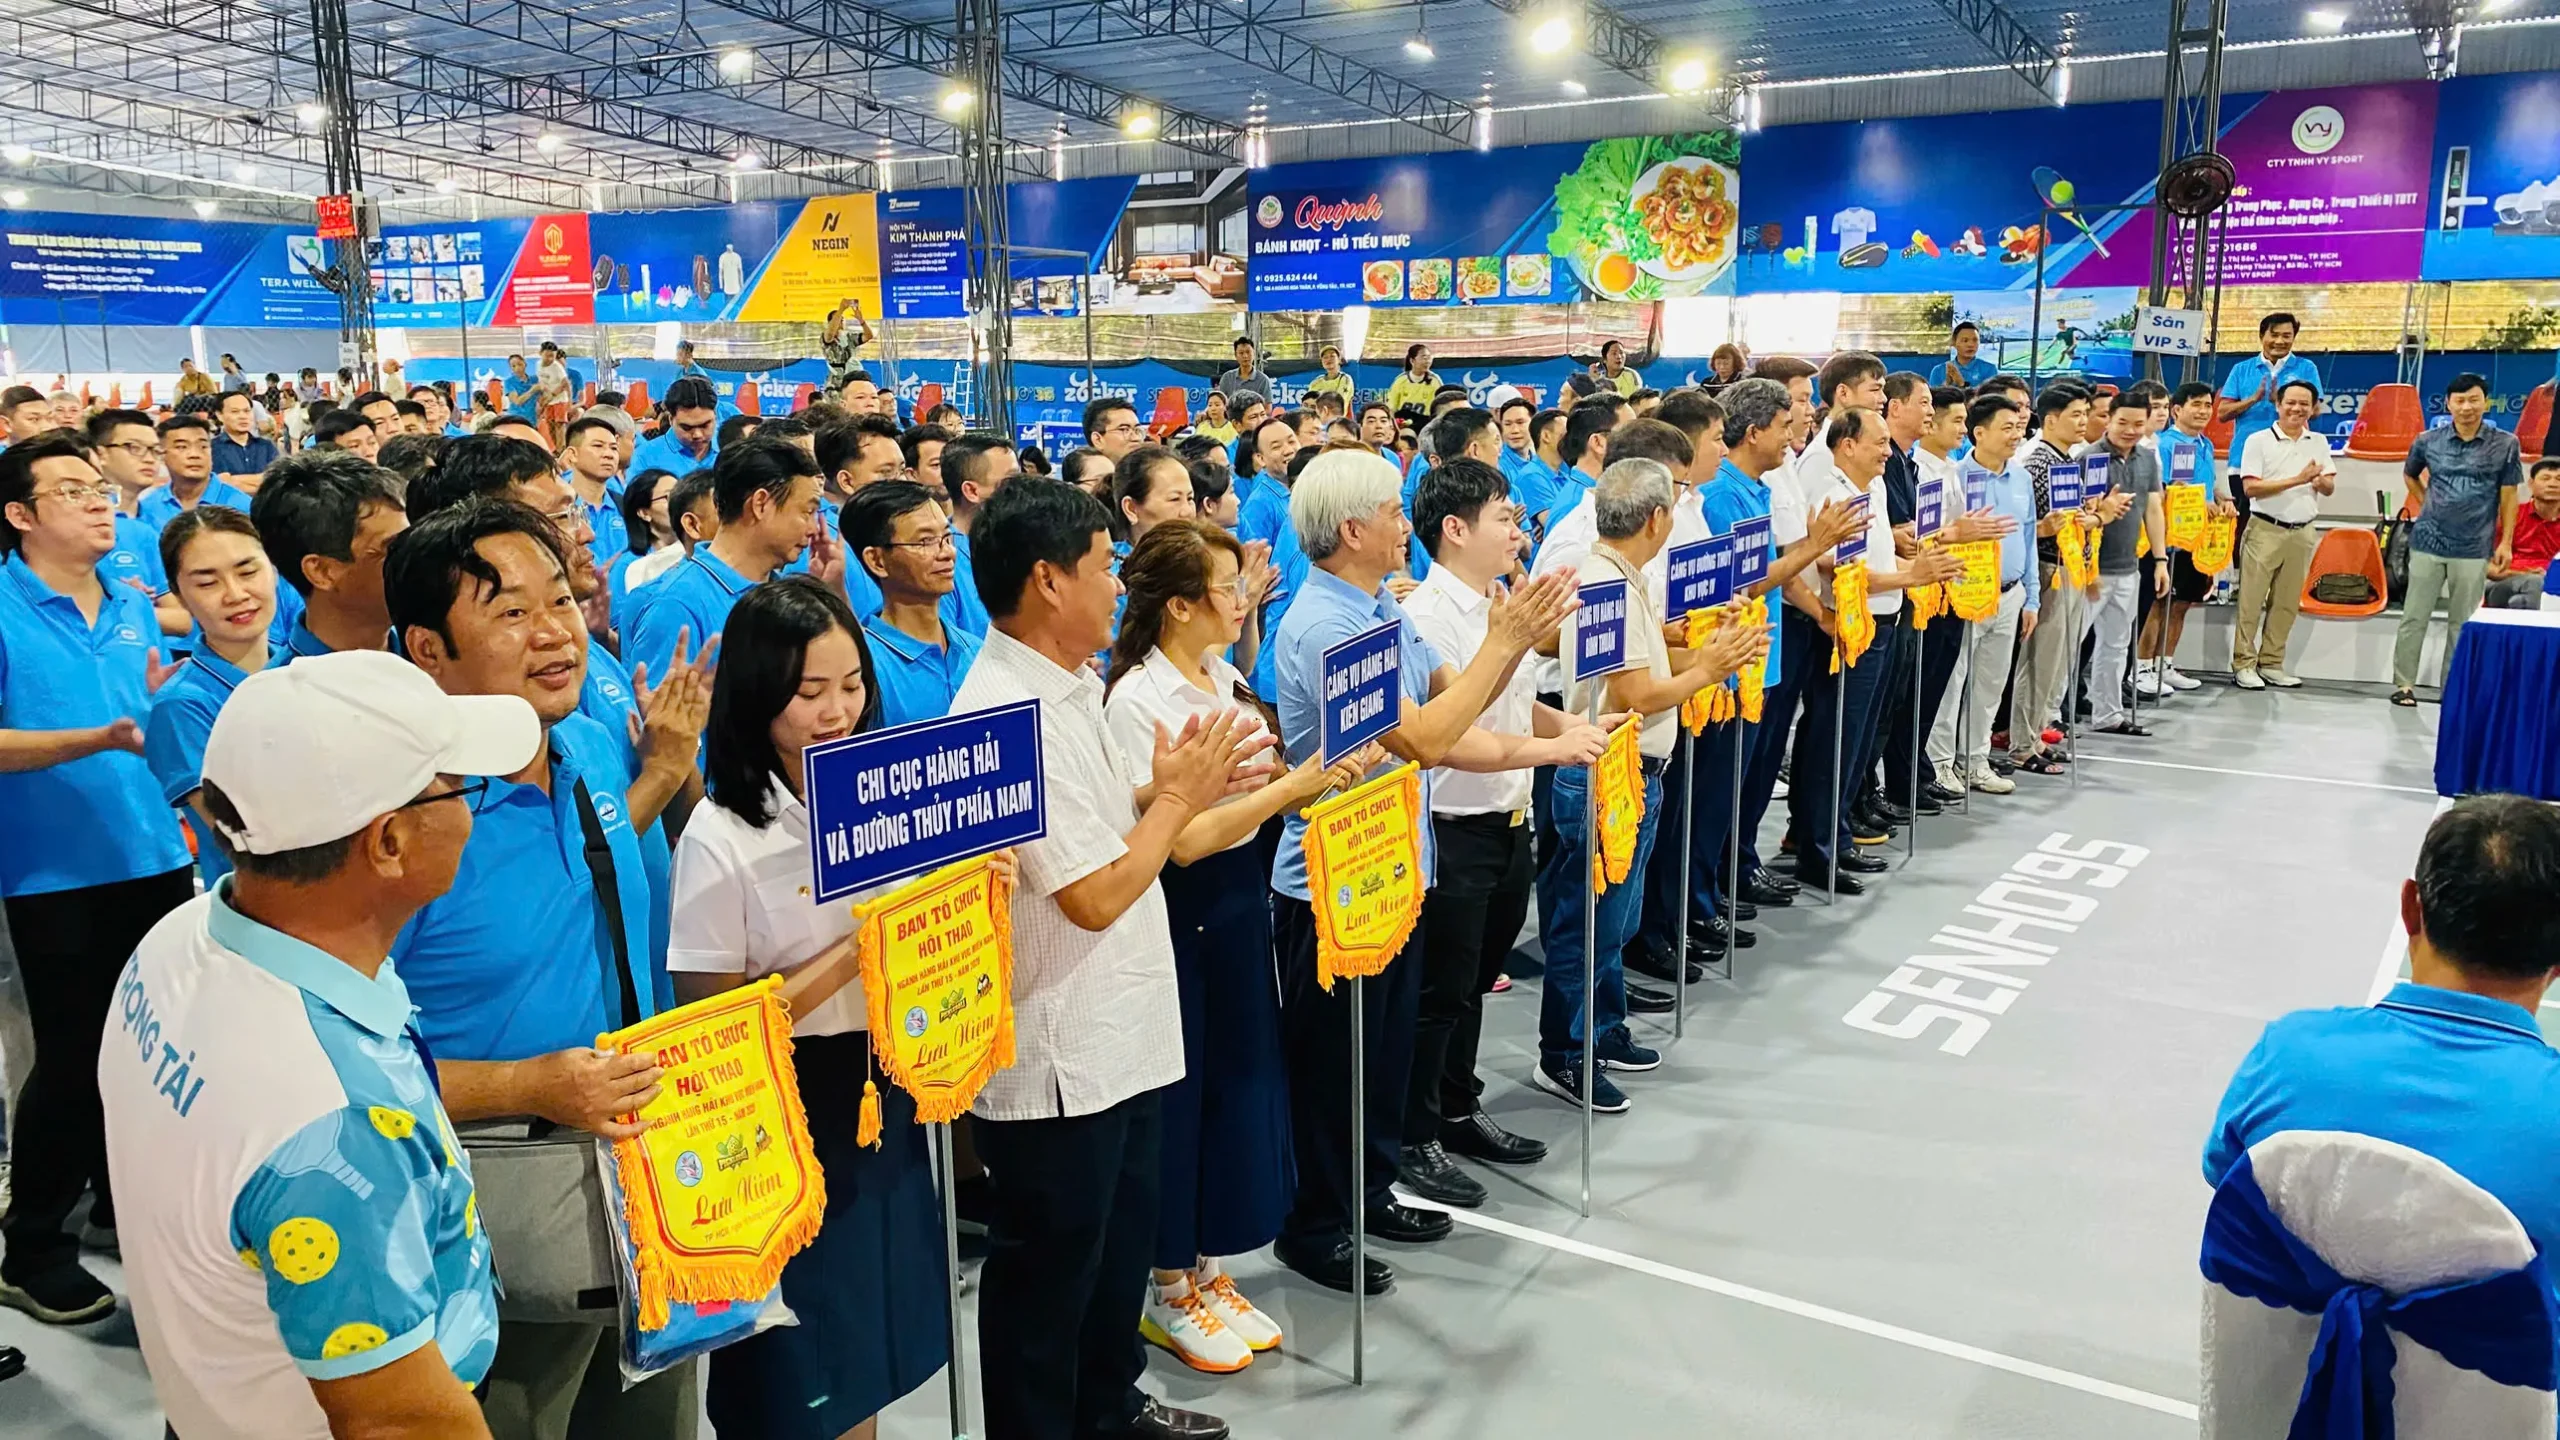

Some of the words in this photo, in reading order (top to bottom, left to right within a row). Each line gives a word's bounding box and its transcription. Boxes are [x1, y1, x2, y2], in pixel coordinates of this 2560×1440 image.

[2267, 159, 2285, 168] CTY
[2288, 157, 2314, 167] TNHH
[2316, 156, 2329, 165] VY
[2331, 155, 2364, 165] SPORT
[1294, 193, 1384, 232] Quỳnh
[812, 237, 850, 251] NEGIN
[890, 231, 907, 243] KIM
[909, 229, 943, 242] THÀNH
[1255, 239, 1287, 254] BÁNH
[1290, 239, 1321, 254] KHỌT
[1332, 234, 1350, 250] HỦ
[1352, 232, 1379, 249] TIẾU
[1382, 234, 1411, 250] MỰC
[260, 278, 290, 287] TERA
[1302, 273, 1318, 281] 444
[2152, 315, 2185, 329] Sân
[2144, 335, 2172, 347] VIP
[2177, 338, 2187, 349] 3
[1327, 665, 1348, 701] CẢNG
[1349, 661, 1360, 692] VỤ
[1361, 652, 1383, 684] HÀNG
[1384, 639, 1398, 672] HẢI
[1340, 699, 1359, 734] KIÊN
[1360, 688, 1384, 722] GIANG
[857, 766, 886, 805] CHI
[889, 758, 922, 800] CỤC
[926, 745, 970, 787] HÀNG
[973, 731, 1001, 775] HẢI
[825, 822, 850, 866] VÀ
[852, 811, 910, 859] ĐƯỜNG
[912, 792, 952, 841] THỦY
[956, 786, 994, 829] PHÍA
[996, 780, 1033, 819] NAM
[1329, 815, 1352, 837] BAN
[1356, 803, 1368, 826] TỔ
[1369, 794, 1397, 816] CHỨC
[1347, 831, 1362, 851] HỘI
[1364, 821, 1386, 841] THAO
[897, 911, 927, 942] BAN
[931, 894, 951, 925] TỔ
[954, 884, 982, 914] CHỨC
[918, 934, 942, 959] HỘI
[945, 920, 973, 947] THAO
[657, 1041, 689, 1071] AN
[689, 1025, 714, 1059] TỔ
[714, 1019, 750, 1050] CHỨC
[911, 1040, 949, 1070] Lưu
[954, 1013, 995, 1043] Niệm
[676, 1073, 710, 1097] HỘI
[711, 1058, 744, 1086] THAO
[701, 1116, 716, 1132] THỨ
[716, 1115, 728, 1128] 15
[702, 1097, 718, 1113] HẢI
[690, 1194, 734, 1229] Lưu
[737, 1171, 785, 1205] Niệm
